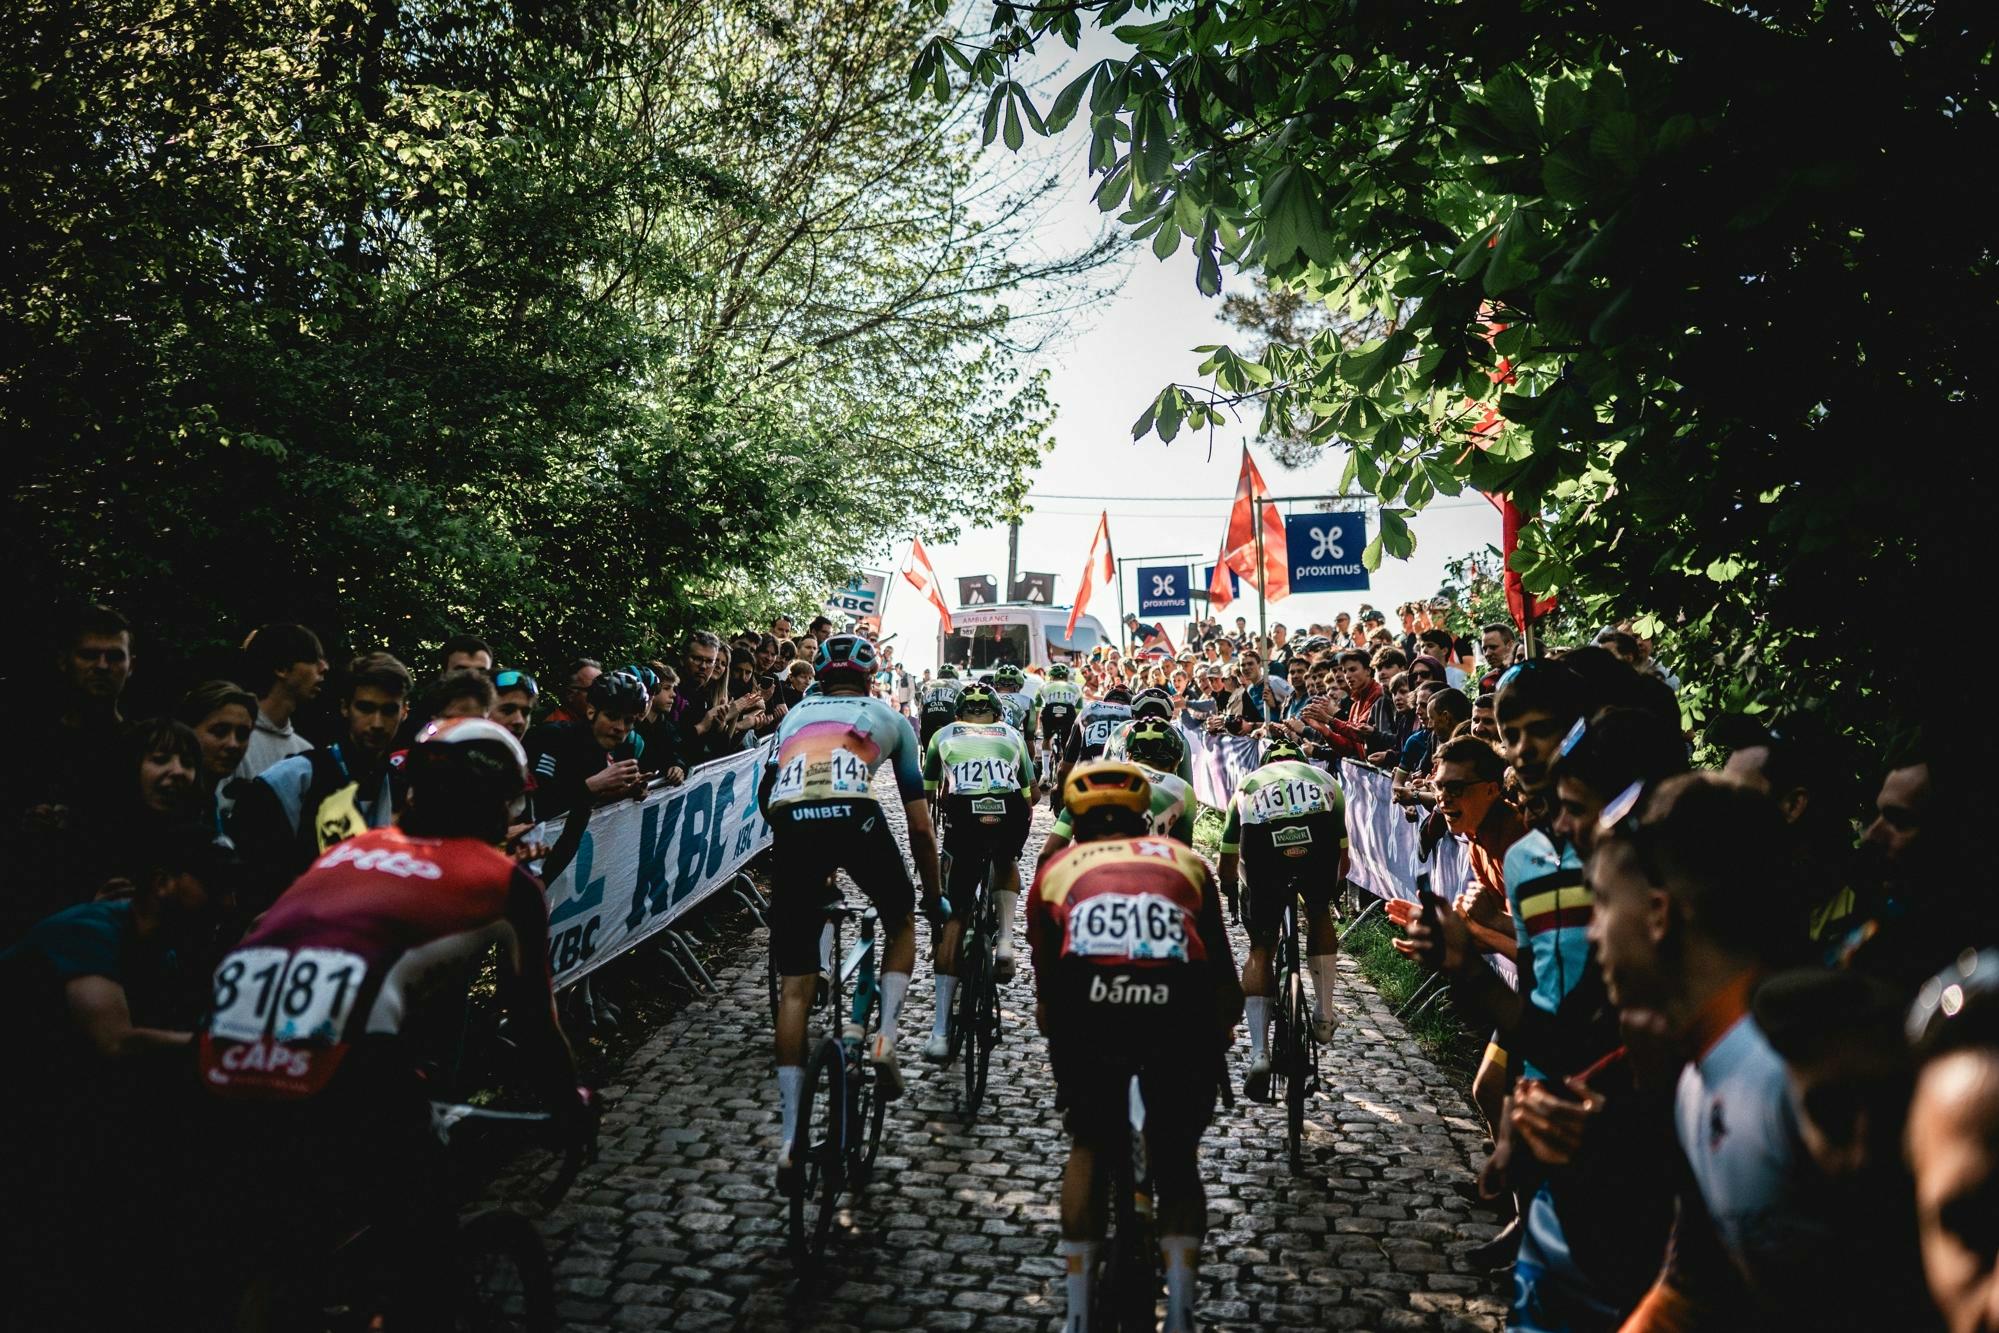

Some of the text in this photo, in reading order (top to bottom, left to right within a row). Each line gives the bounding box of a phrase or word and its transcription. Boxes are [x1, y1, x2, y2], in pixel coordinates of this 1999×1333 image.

[1296, 562, 1361, 579] proximus
[826, 593, 875, 613] KBC
[1143, 597, 1186, 608] proximus
[962, 615, 1009, 624] AMBULANCE
[833, 756, 867, 781] 141
[953, 760, 1015, 784] 112 112
[1286, 782, 1320, 805] 115
[793, 805, 852, 821] UNIBET
[1276, 831, 1308, 842] WAGNER
[626, 770, 756, 933] KBC KBC
[1069, 902, 1186, 944] 165 165
[215, 960, 354, 1019] 81 81
